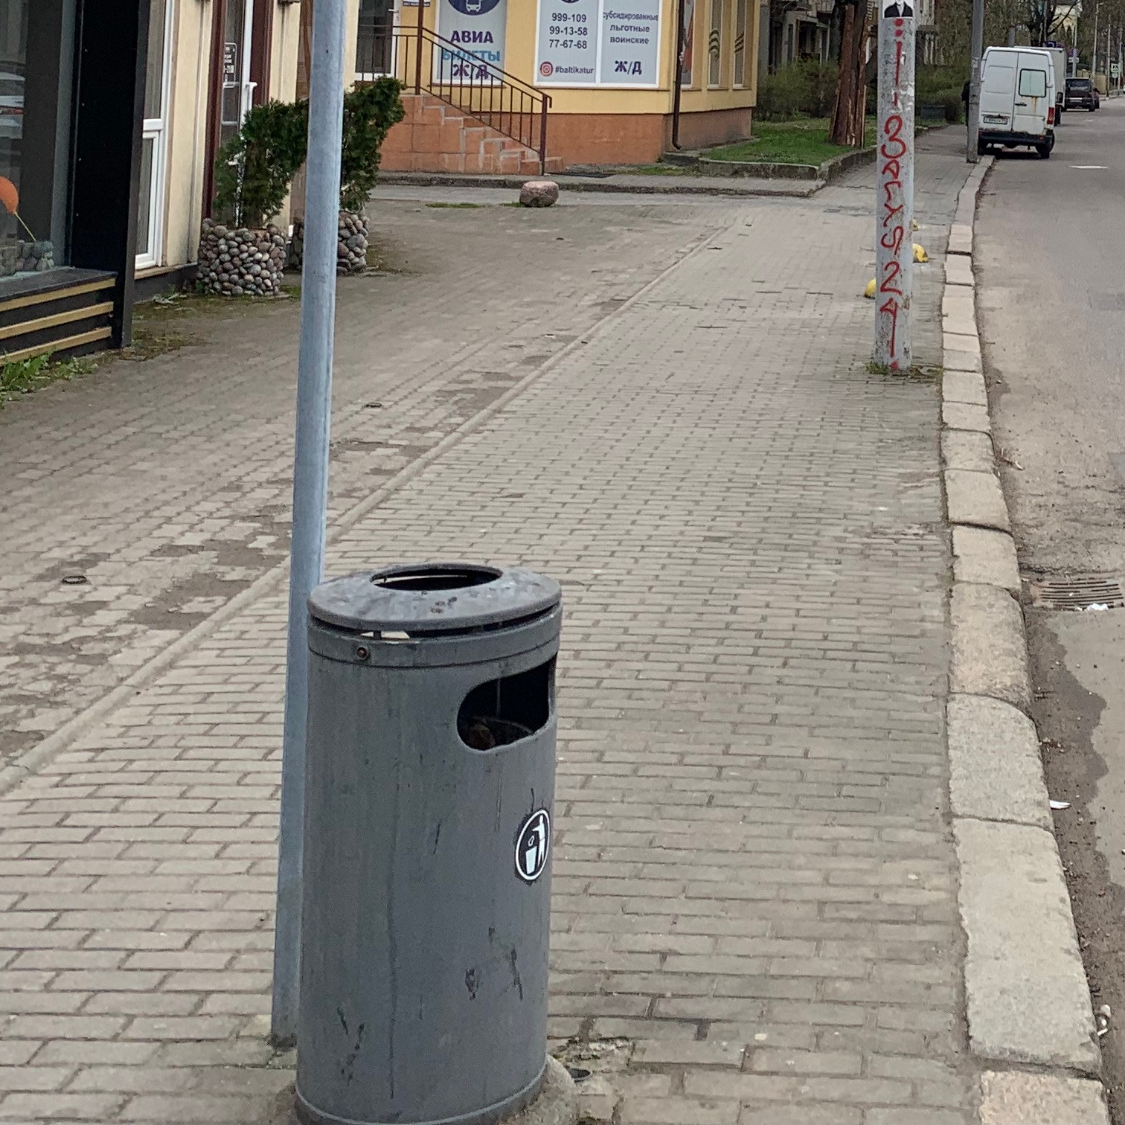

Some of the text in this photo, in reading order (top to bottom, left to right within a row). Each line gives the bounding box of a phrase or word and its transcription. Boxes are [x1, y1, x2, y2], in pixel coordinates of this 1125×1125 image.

[551, 12, 587, 23] 999-109
[549, 25, 588, 36] 99-13-58
[609, 24, 650, 33] льготные
[451, 30, 494, 43] АВИА
[609, 36, 650, 45] воинские
[549, 39, 588, 50] 77-67-68
[615, 60, 643, 75] Ж/Д
